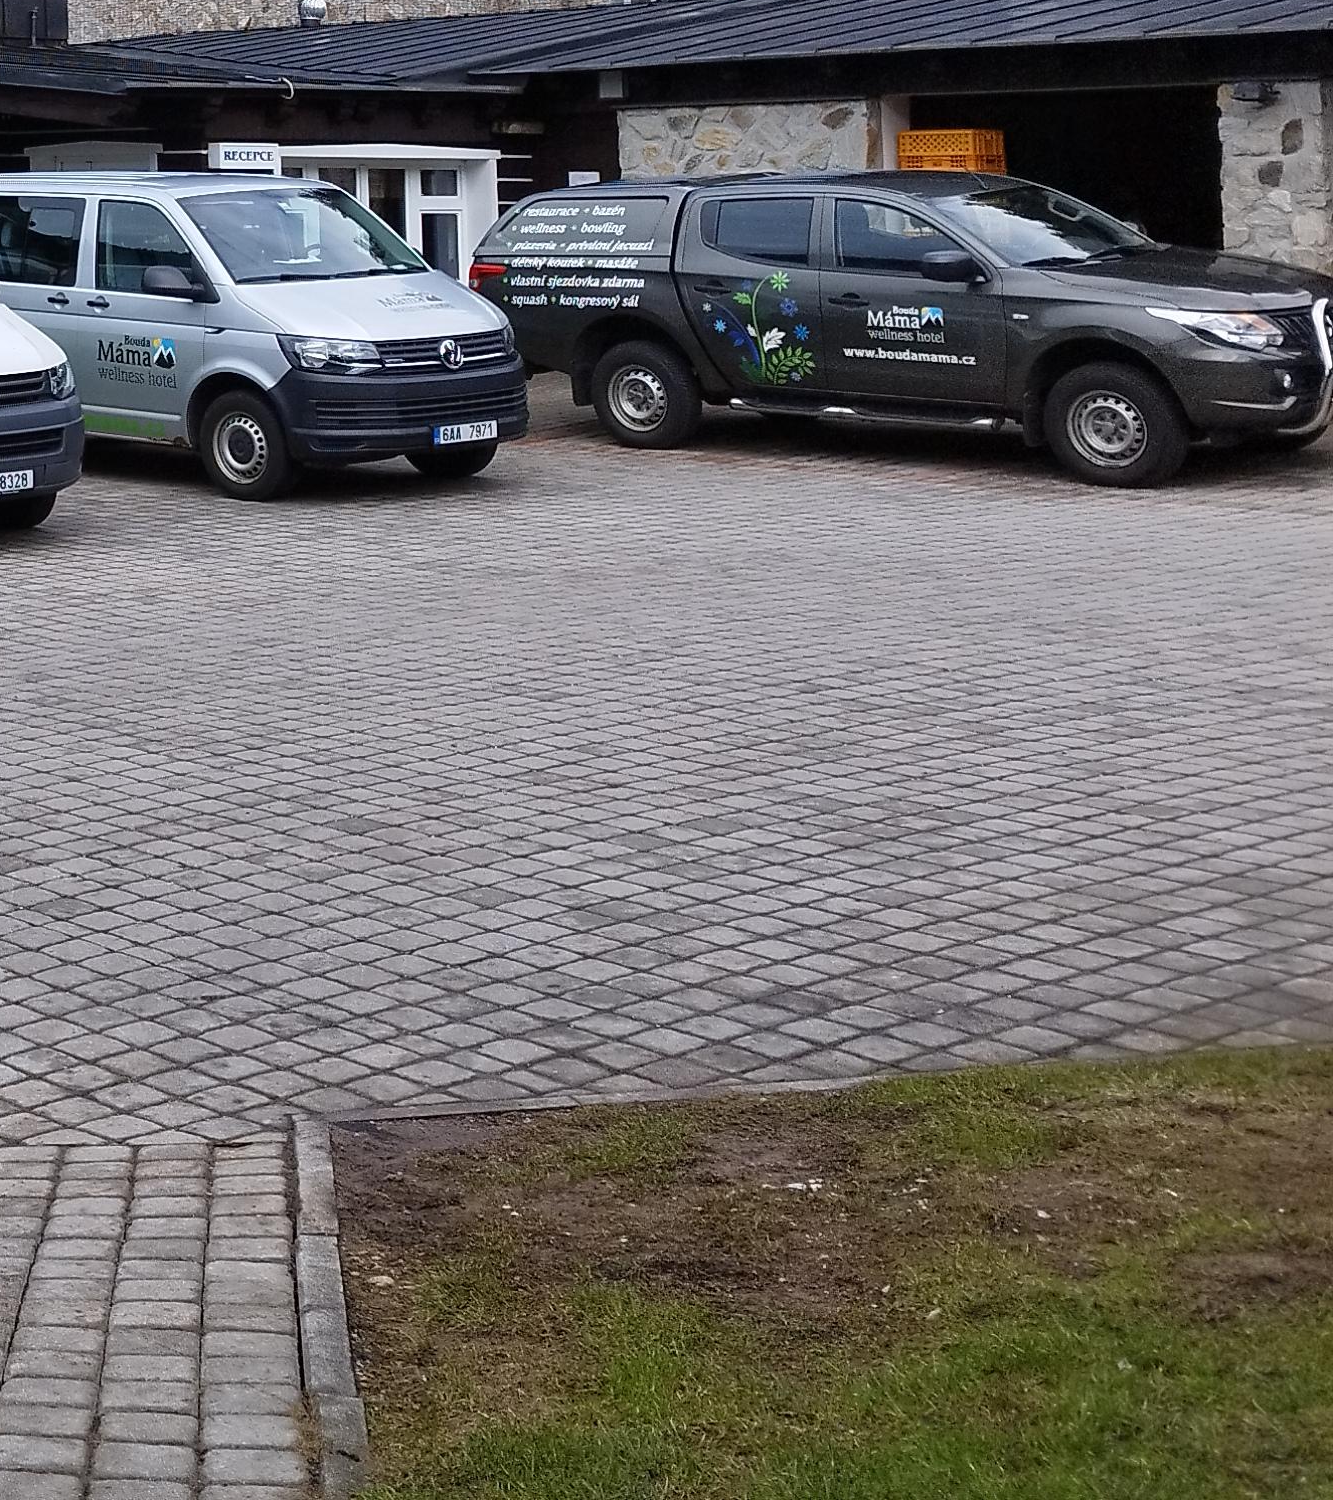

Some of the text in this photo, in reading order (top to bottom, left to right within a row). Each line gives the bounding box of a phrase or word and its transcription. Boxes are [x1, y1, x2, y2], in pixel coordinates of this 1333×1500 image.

[223, 150, 274, 162] RECEPCE
[523, 204, 626, 217] restaurace bazén
[520, 222, 627, 236] wellness bowling
[510, 274, 645, 290] vlastní sjezdovka zdarma
[511, 294, 640, 310] squash kongresový sál
[892, 305, 920, 316] Bouda
[867, 310, 921, 329] Máma
[124, 335, 151, 348] Bouda
[866, 329, 945, 344] wellness hotel
[97, 339, 152, 368] Máma
[842, 347, 977, 366] www.boudamama.cz
[97, 367, 177, 389] wellness hotel
[442, 422, 493, 442] 6AA 7971
[0, 472, 28, 490] 8328
